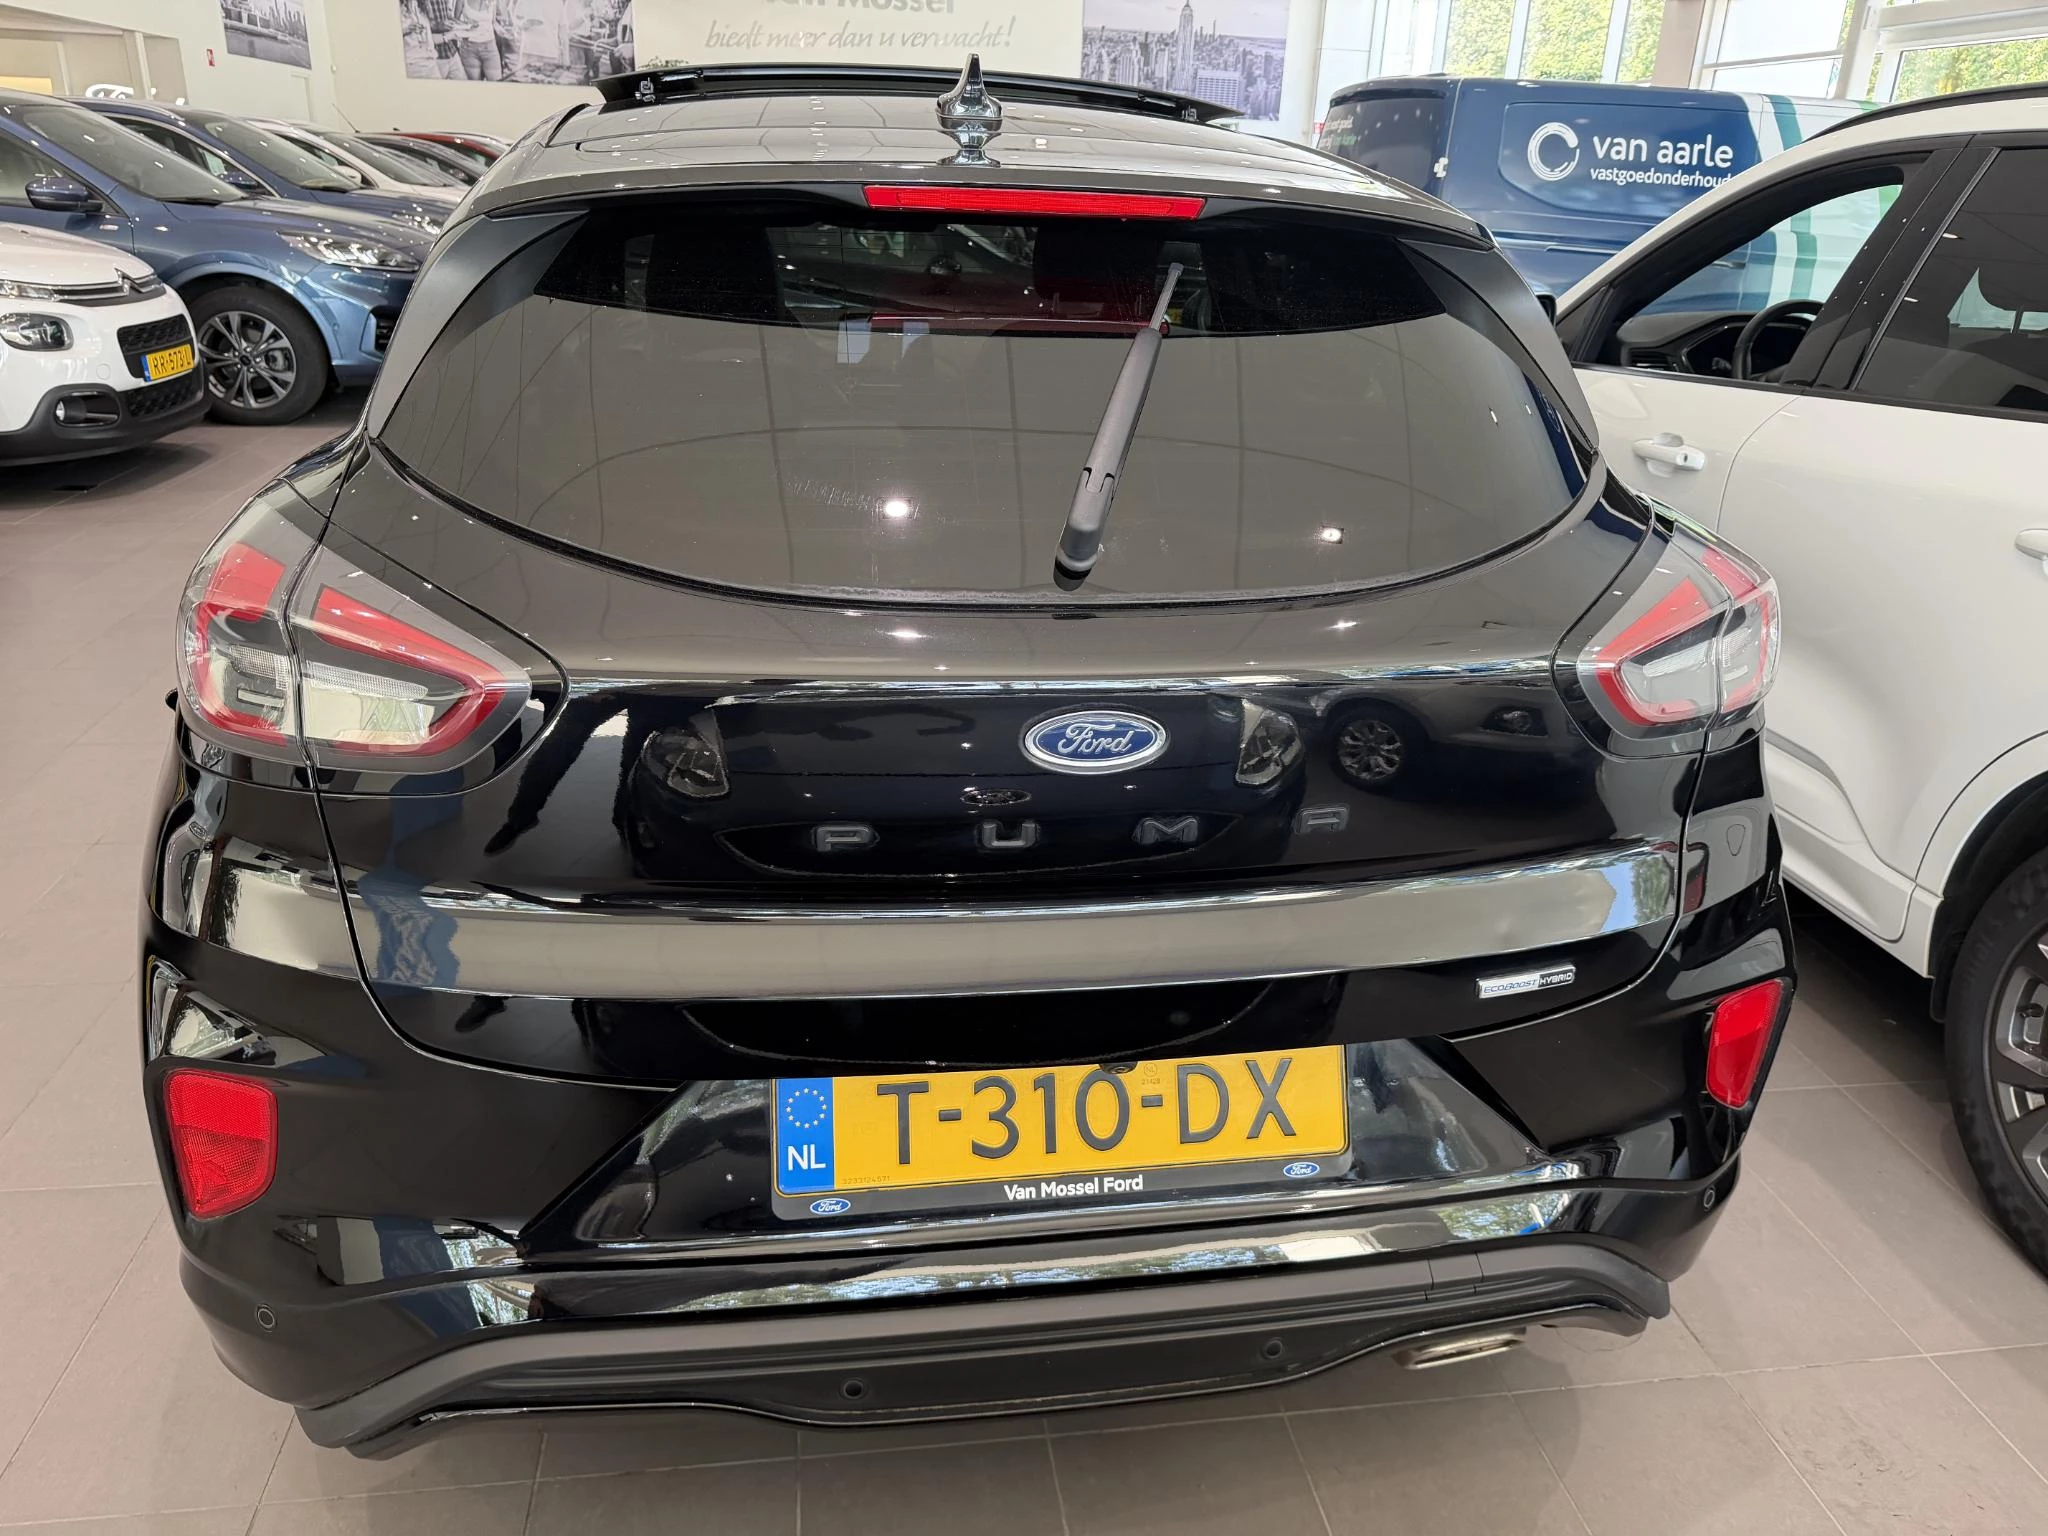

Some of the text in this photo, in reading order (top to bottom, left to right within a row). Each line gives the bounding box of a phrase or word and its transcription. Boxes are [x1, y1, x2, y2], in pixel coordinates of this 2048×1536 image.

[704, 19, 764, 50] biedt
[828, 20, 873, 48] dan
[879, 32, 895, 47] u
[1592, 133, 1734, 168] van aarle
[1057, 723, 1135, 754] Ford
[816, 806, 1349, 852] PUMA
[1540, 972, 1573, 986] HYBRID
[877, 1057, 1297, 1166] T-310-DX
[788, 1144, 826, 1171] NL
[1003, 1174, 1143, 1200] Van Mossel Ford
